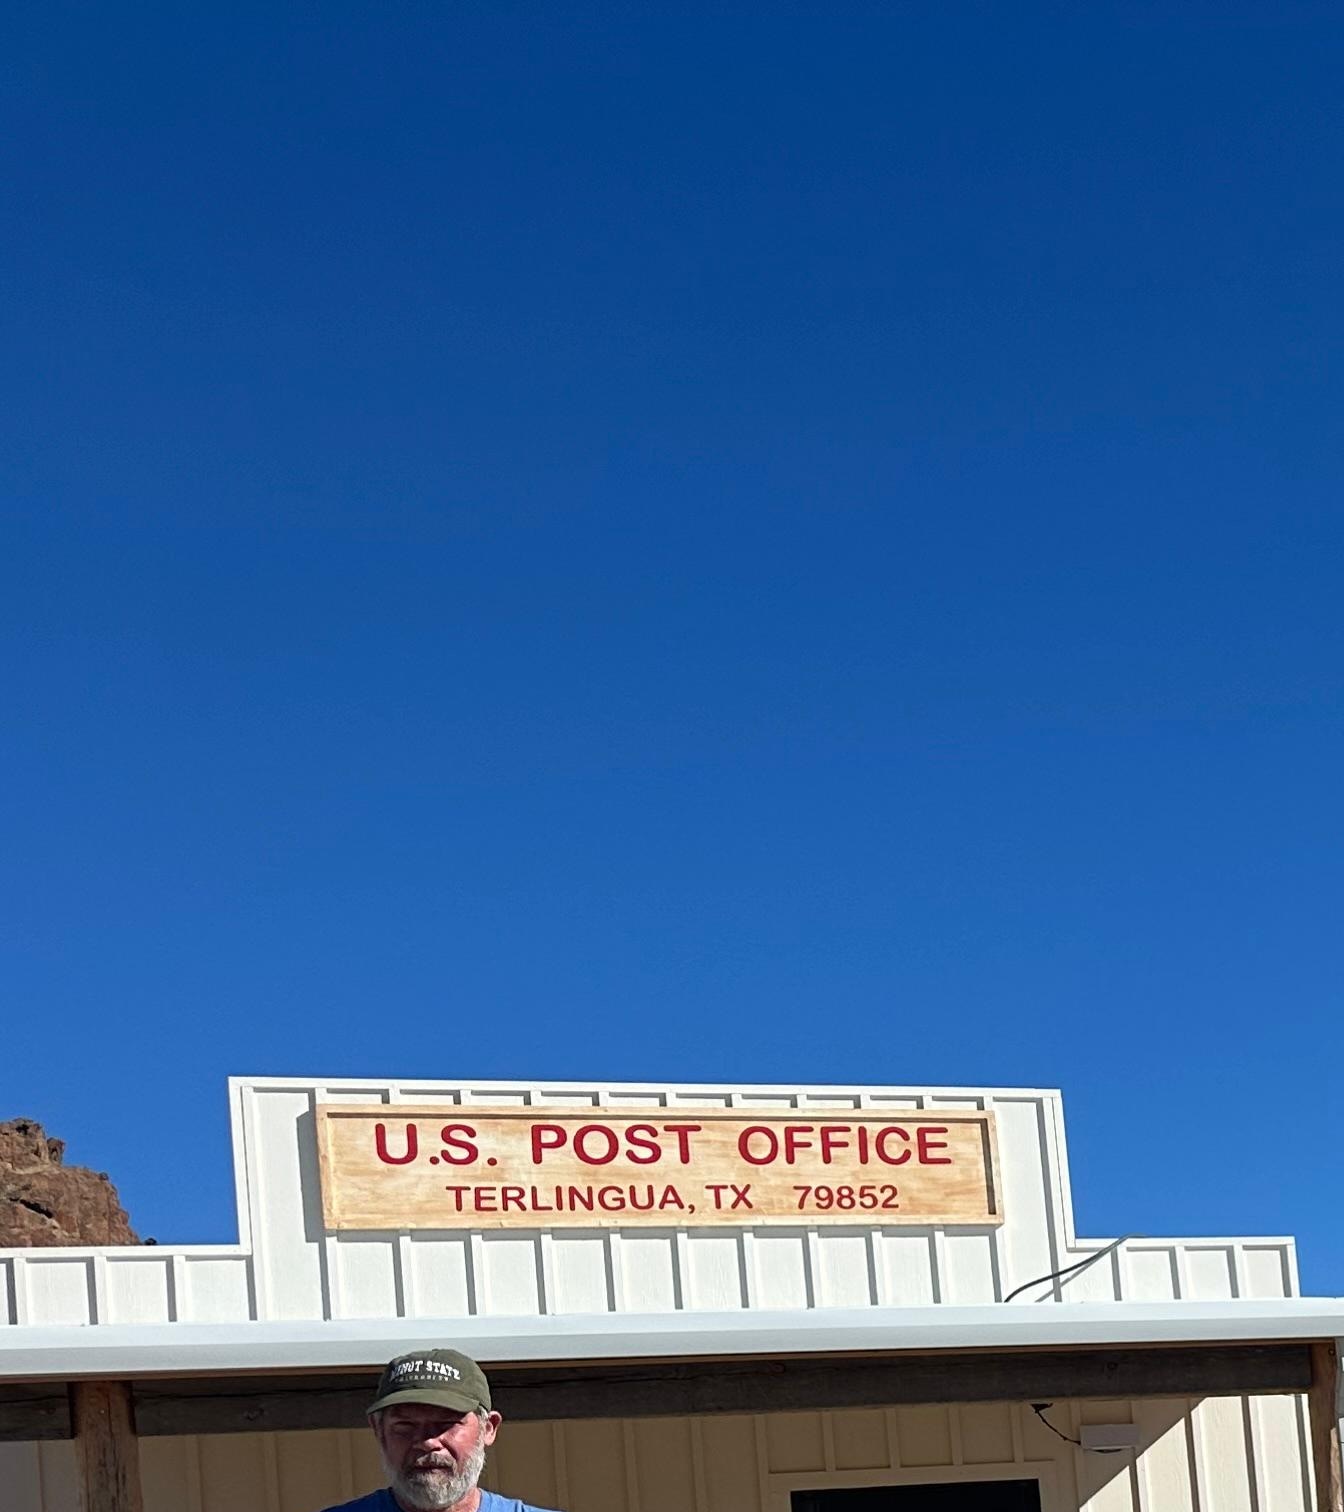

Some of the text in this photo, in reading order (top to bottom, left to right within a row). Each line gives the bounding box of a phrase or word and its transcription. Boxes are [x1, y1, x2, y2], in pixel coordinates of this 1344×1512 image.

[374, 1123, 952, 1166] U.S. POST OFFICE
[445, 1183, 900, 1214] TERLINGUA, TX 79852
[426, 1360, 461, 1381] STATE
